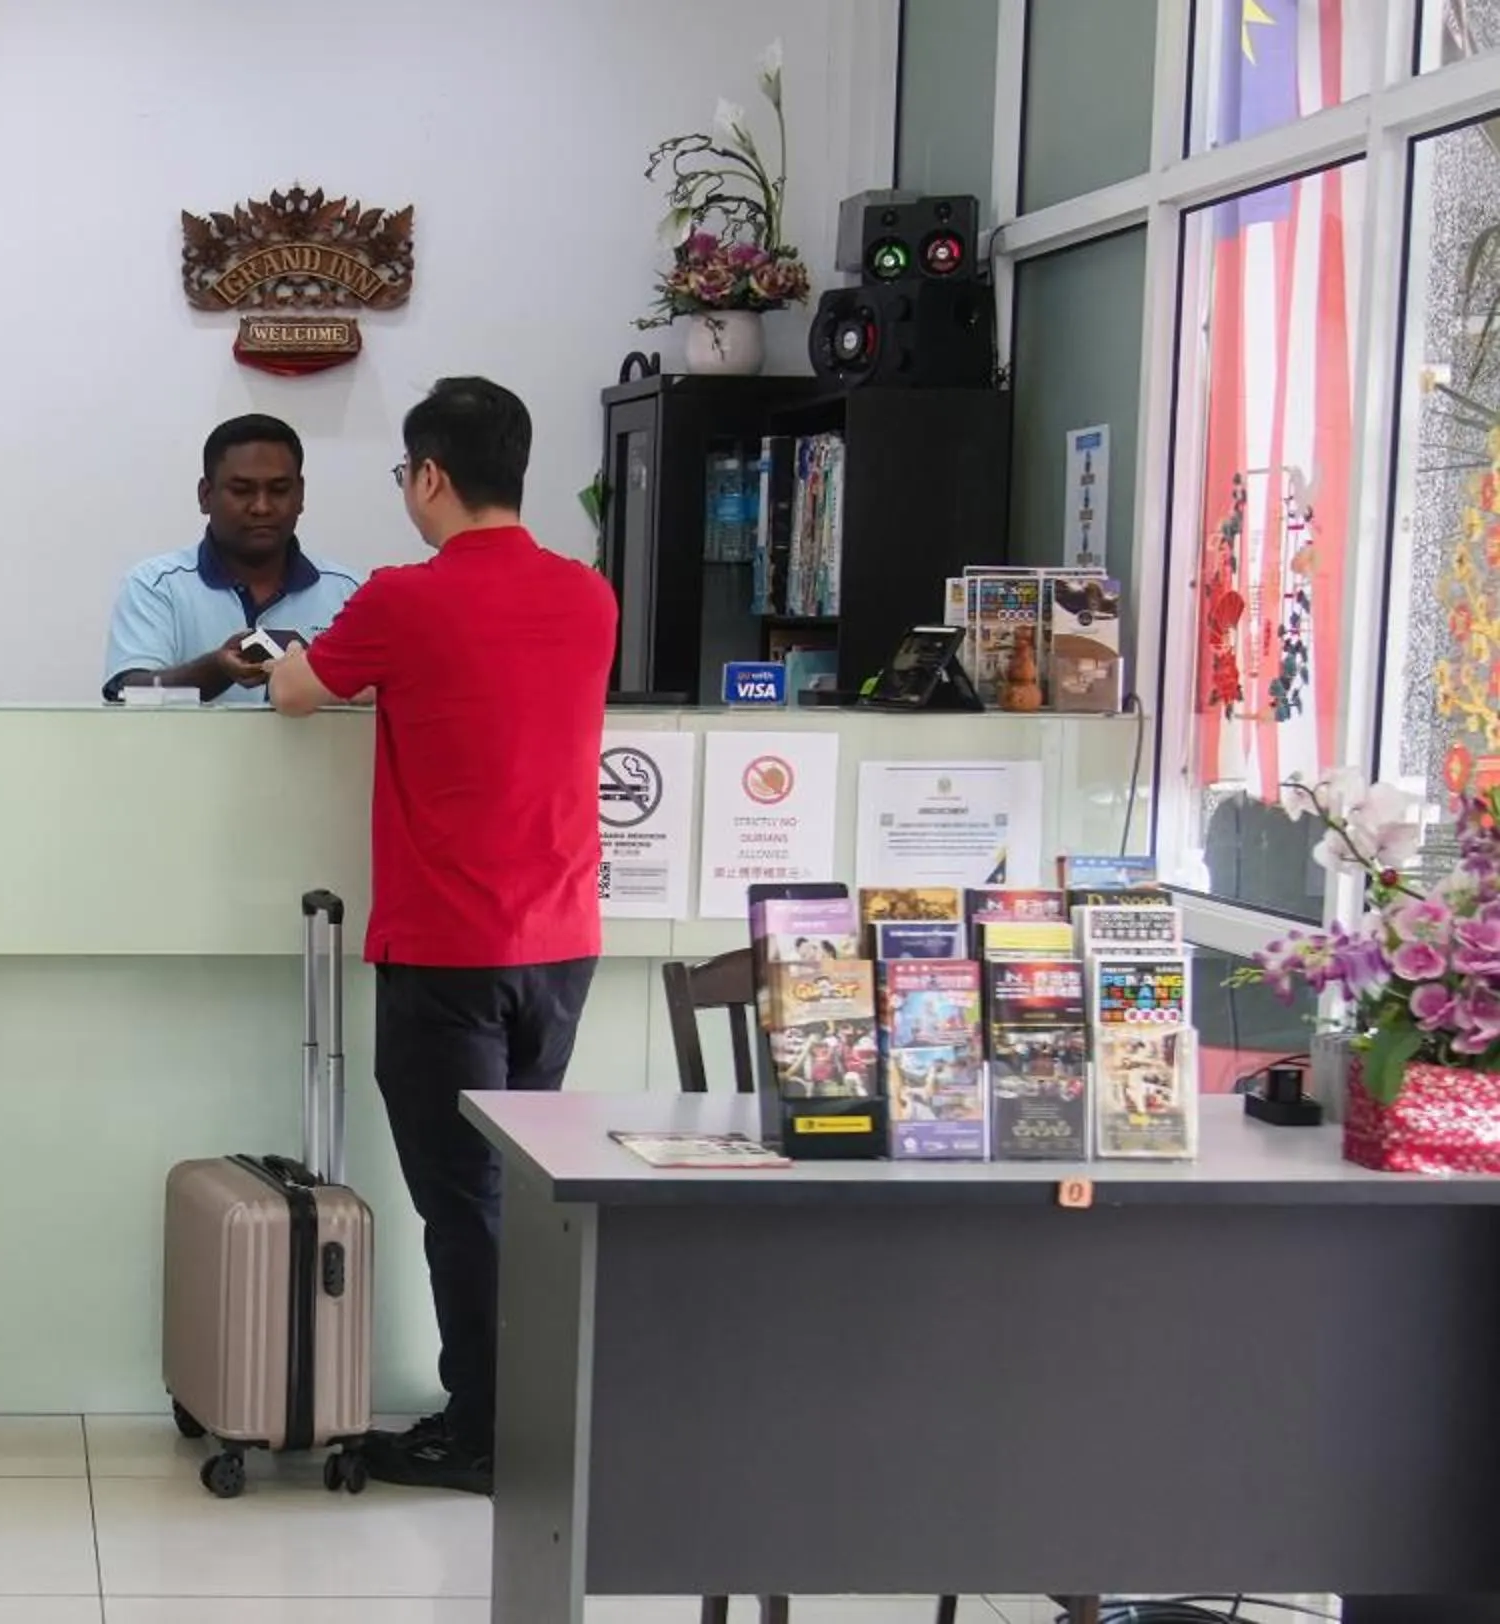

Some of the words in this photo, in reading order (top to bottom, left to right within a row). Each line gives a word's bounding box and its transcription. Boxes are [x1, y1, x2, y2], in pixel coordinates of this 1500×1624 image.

[222, 247, 322, 293] GRAND
[329, 254, 379, 293] INN
[253, 326, 344, 342] WELCOME
[737, 683, 776, 699] VISA
[733, 816, 778, 827] STRICTLY
[780, 816, 798, 827] NO
[739, 833, 789, 844] DURIANS
[737, 849, 790, 860] ALLOWED
[1101, 974, 1184, 987] PENANG
